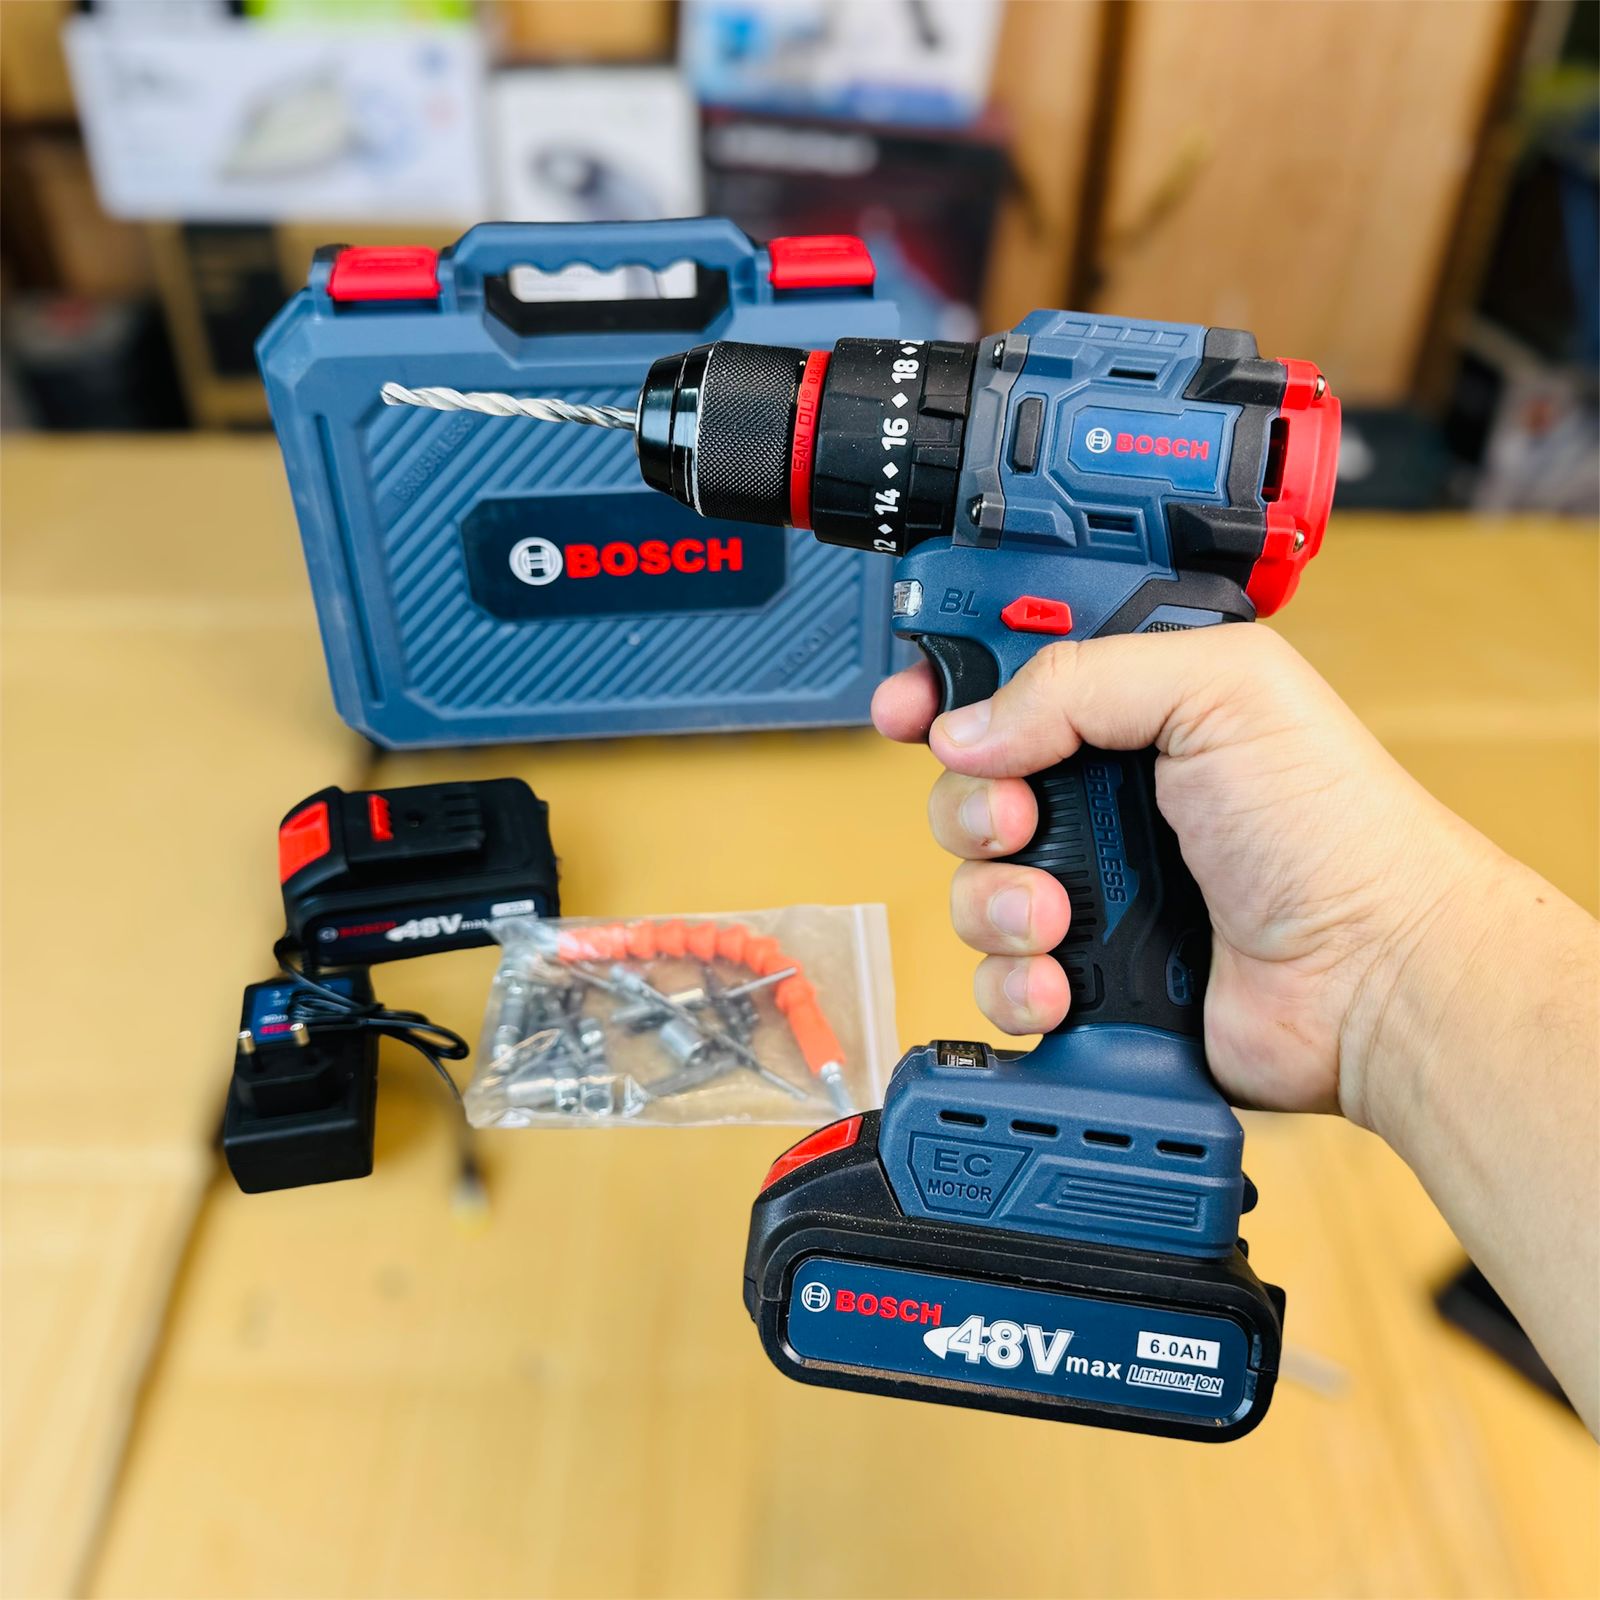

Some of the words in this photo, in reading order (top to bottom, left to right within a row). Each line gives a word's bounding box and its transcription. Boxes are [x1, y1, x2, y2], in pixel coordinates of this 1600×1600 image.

[891, 358, 920, 384] 18
[881, 417, 910, 451] 16
[1115, 432, 1210, 461] BOSCH
[794, 434, 810, 473] SAN
[874, 488, 901, 516] 14
[564, 536, 744, 579] BOSCH
[873, 538, 897, 552] 12
[939, 587, 980, 618] BL
[1086, 765, 1129, 904] BRUSHLESS
[400, 913, 463, 940] 48V
[932, 1147, 993, 1178] EC
[926, 1178, 994, 1204] MOTOR
[835, 1289, 943, 1327] BOSCH
[946, 1314, 1075, 1376] 48V
[1065, 1354, 1122, 1381] max
[1149, 1338, 1208, 1362] 6.0Ah
